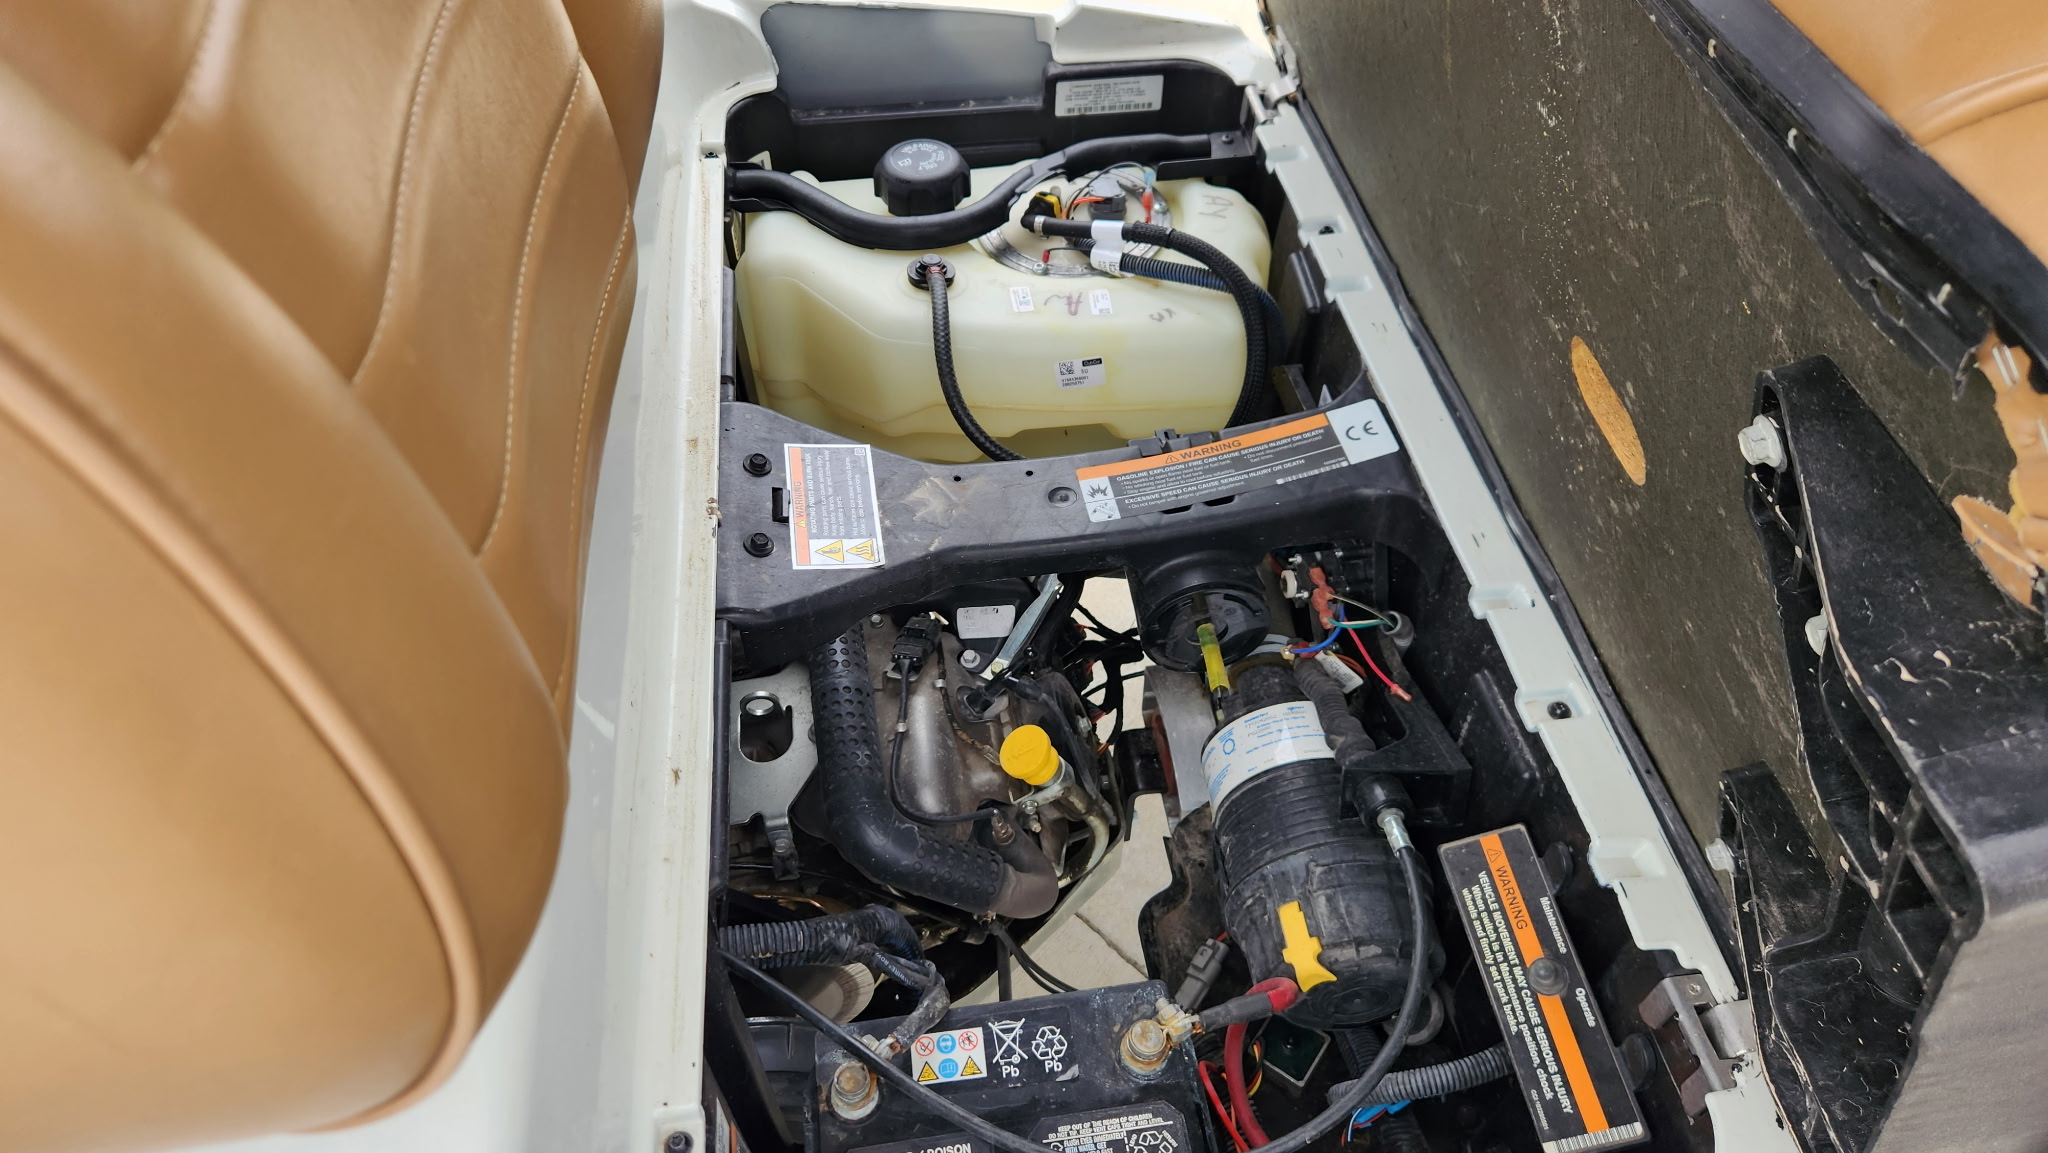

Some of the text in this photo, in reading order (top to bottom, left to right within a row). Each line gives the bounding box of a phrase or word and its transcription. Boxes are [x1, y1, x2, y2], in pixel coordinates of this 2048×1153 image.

[1116, 471, 1147, 480] GASOLINE
[1149, 464, 1184, 474] EXPLOSION
[1217, 451, 1240, 459] CAUSE
[1240, 444, 1268, 454] SERIOUS
[1268, 437, 1291, 446] INJURY
[1301, 429, 1325, 437] DEATH
[1180, 440, 1242, 459] WARNING
[793, 481, 803, 517] WARNING
[1125, 493, 1159, 503] EXCESSIVE
[1219, 473, 1248, 484] SERIOUS
[1248, 468, 1271, 477] INJURY
[1282, 459, 1305, 468] DEATH
[809, 508, 817, 532] ROTATING
[1495, 865, 1528, 931] WARNING
[1539, 896, 1569, 955] Maintenance
[1461, 887, 1521, 1035] wheels and firmly set park brake.
[1470, 884, 1555, 1100] When switch is in Maintenance position, chock
[1477, 870, 1573, 1115] VEHICLE MOVEMENT MAY CAUSE SERIOUS INJURY
[1573, 986, 1598, 1028] Operate
[1002, 1064, 1020, 1078] Pb
[1044, 1059, 1063, 1073] Pb
[1057, 1124, 1071, 1132] KEEP
[1091, 1120, 1103, 1128] THE
[1103, 1118, 1119, 1127] REACH
[1120, 1116, 1128, 1124] OF
[1128, 1113, 1152, 1123] CHILDREN
[1057, 1131, 1069, 1139] NOT
[1080, 1128, 1093, 1136] KEEP
[1121, 1121, 1136, 1130] TIGHT
[1148, 1117, 1164, 1125] LEVEL
[1063, 1132, 1124, 1147] FLUSH EYES IMMEDIATELY
[1065, 1145, 1078, 1153] WITH
[1097, 1141, 1107, 1149] GET
